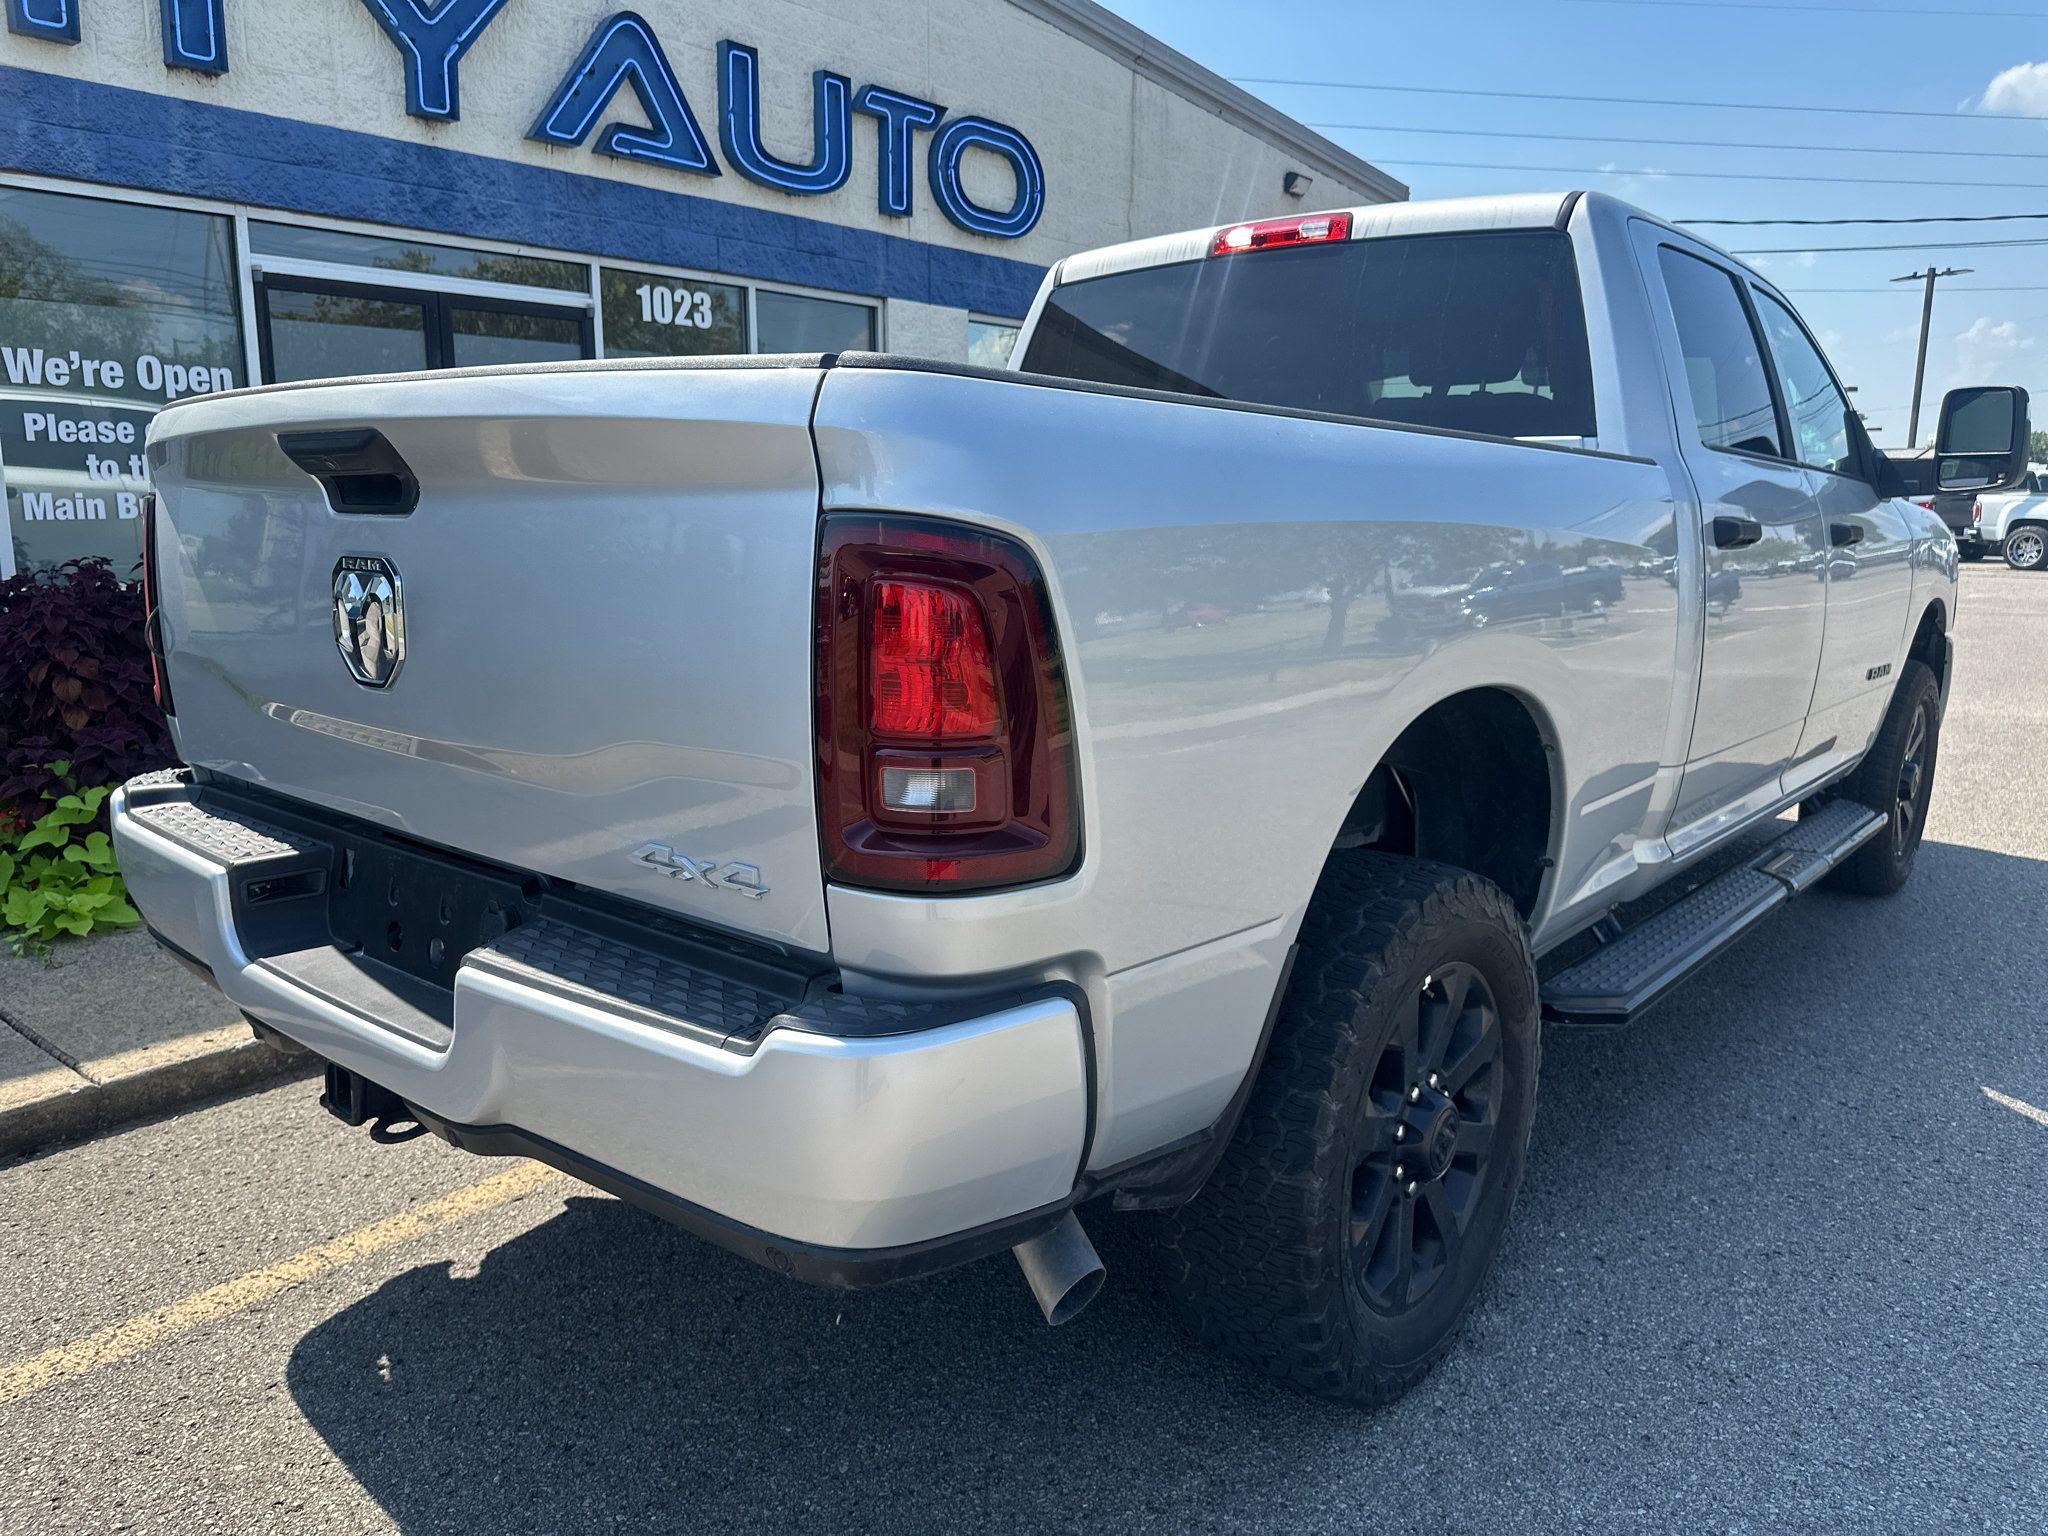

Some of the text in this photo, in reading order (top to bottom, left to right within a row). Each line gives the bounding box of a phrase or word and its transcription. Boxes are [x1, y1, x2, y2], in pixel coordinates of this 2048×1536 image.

[524, 10, 1046, 239] AUTO
[635, 284, 713, 329] 1023
[136, 354, 233, 398] Open
[23, 412, 135, 443] Please
[86, 453, 120, 481] to
[22, 492, 107, 520] Main
[342, 557, 381, 571] RAM
